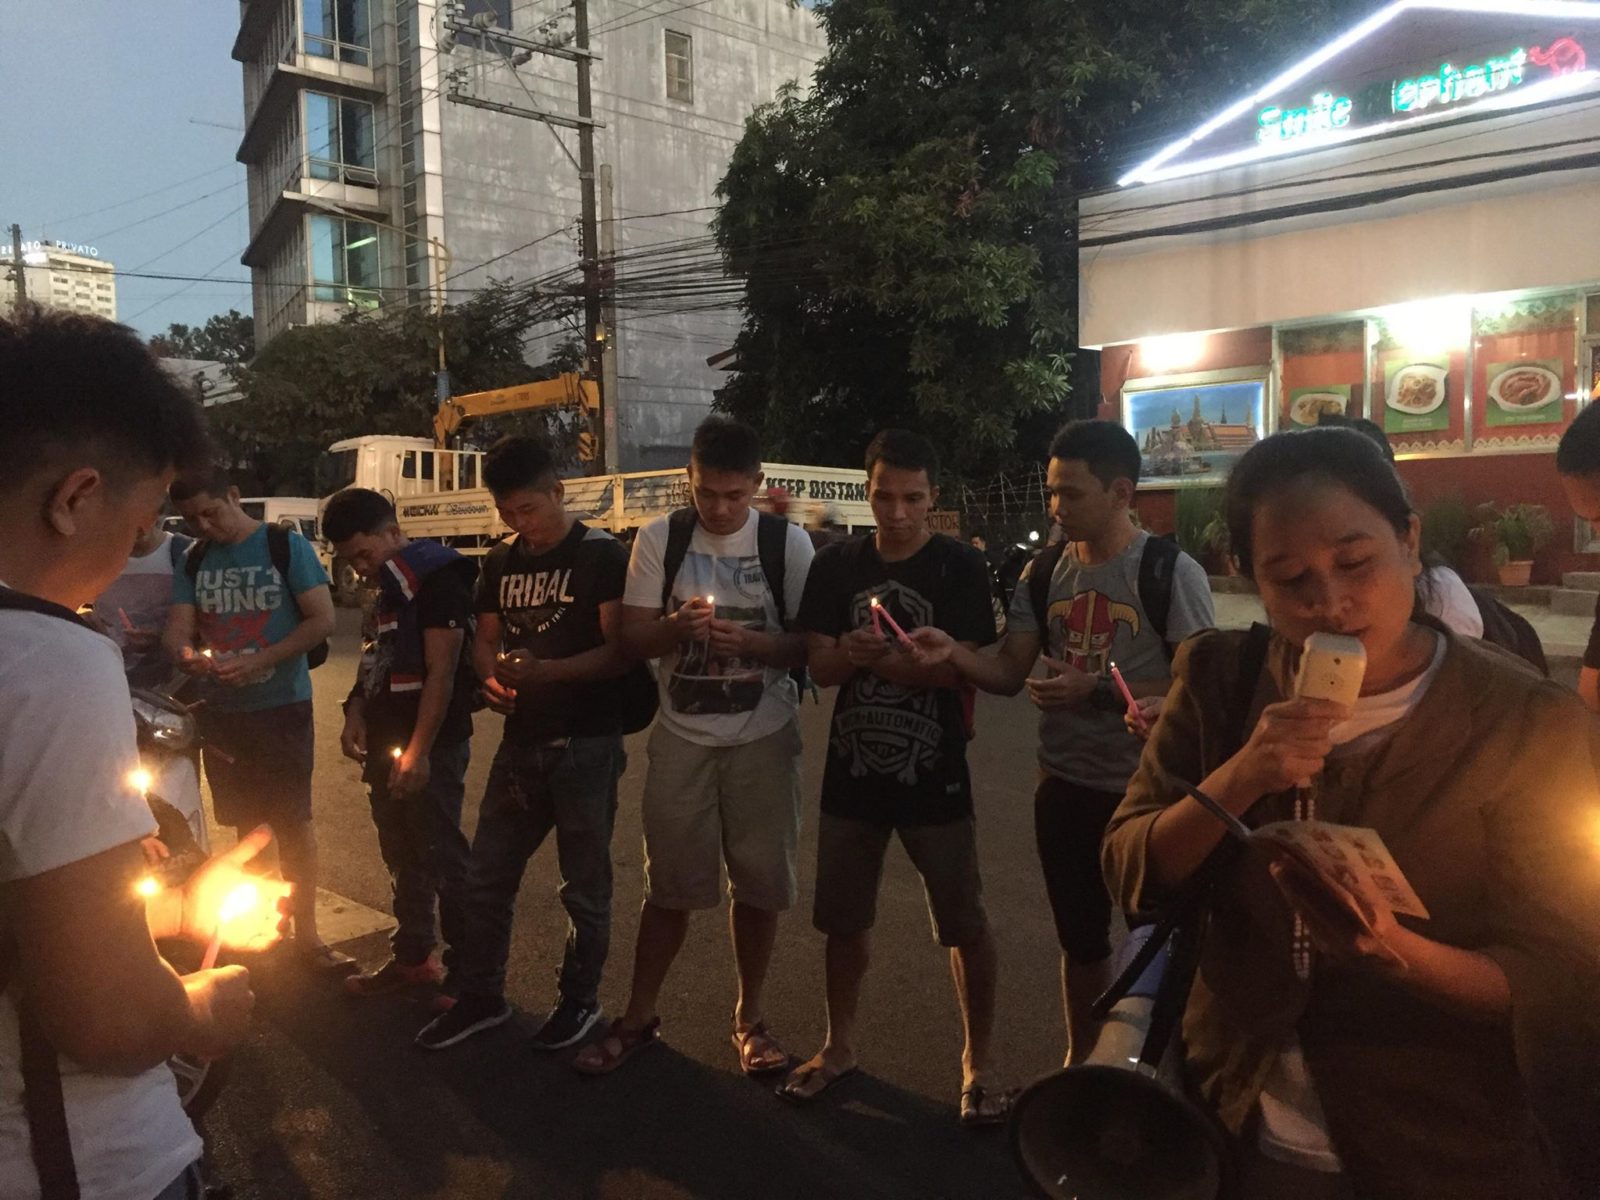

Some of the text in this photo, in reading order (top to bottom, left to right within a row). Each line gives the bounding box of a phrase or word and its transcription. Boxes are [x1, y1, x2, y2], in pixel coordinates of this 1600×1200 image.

[56, 240, 98, 256] PRIVATO
[195, 584, 282, 614] HING
[500, 568, 574, 609] TRIBAL
